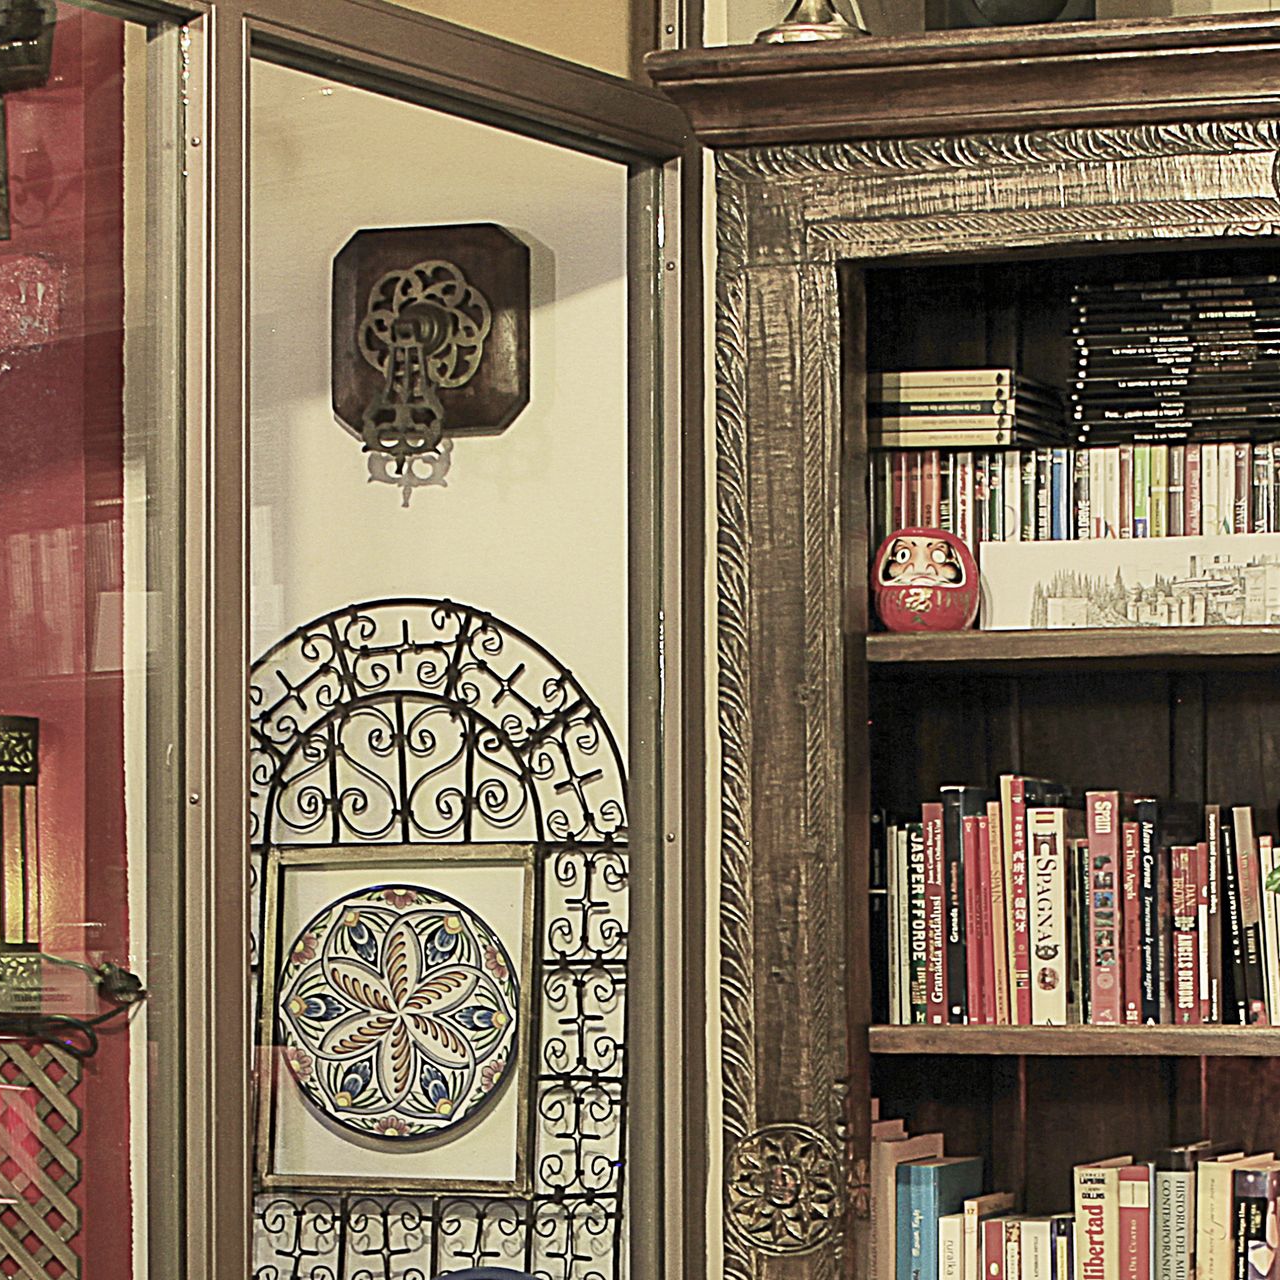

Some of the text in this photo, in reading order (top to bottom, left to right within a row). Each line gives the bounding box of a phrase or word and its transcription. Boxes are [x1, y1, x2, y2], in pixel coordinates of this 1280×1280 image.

[1095, 801, 1112, 834] Spain
[1124, 830, 1137, 900] Less Than Angels
[1142, 822, 1154, 888] Mauro Corona
[911, 832, 926, 961] JASPER FFORDE
[1172, 878, 1184, 914] BROWN
[1186, 884, 1196, 906] DAN
[950, 908, 960, 942] Granada
[930, 948, 943, 1003] Granada
[1178, 934, 1194, 1008] ANGELS DEMONS
[1174, 1180, 1186, 1232] HISTORIA
[1081, 1204, 1104, 1280] libertad
[1129, 1219, 1138, 1253] CUATRO
[1175, 1235, 1186, 1256] DEL
[947, 1240, 957, 1276] ruralka
[1129, 1258, 1138, 1272] DEL
